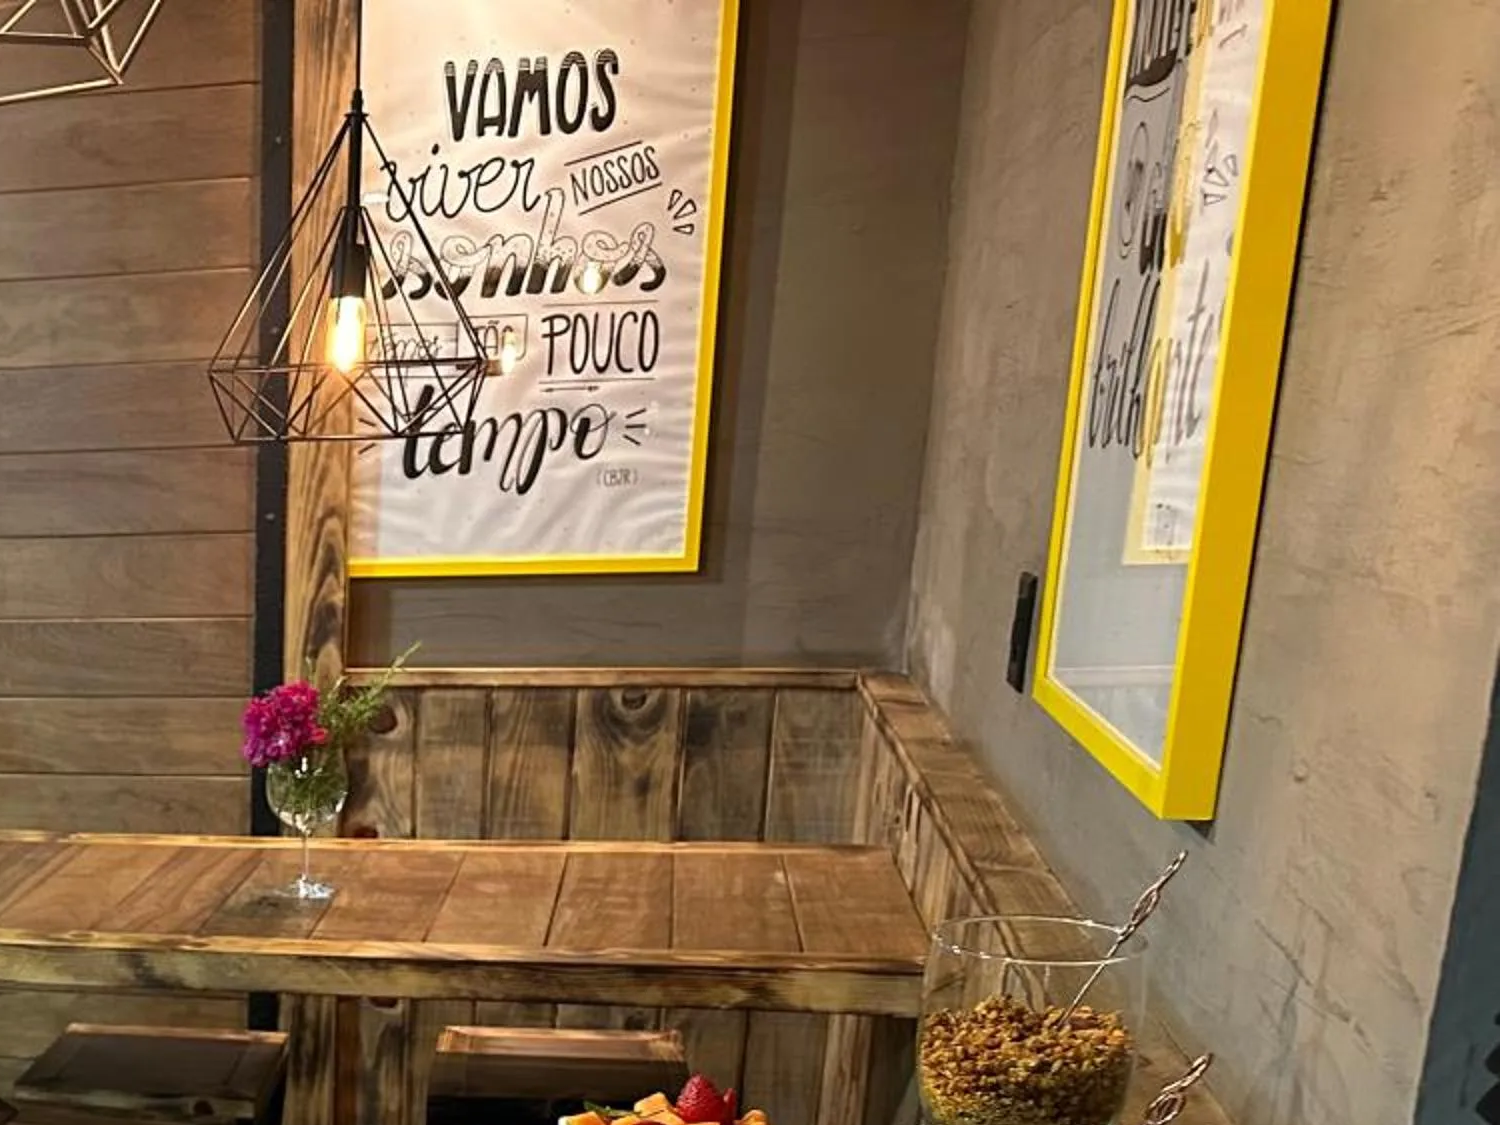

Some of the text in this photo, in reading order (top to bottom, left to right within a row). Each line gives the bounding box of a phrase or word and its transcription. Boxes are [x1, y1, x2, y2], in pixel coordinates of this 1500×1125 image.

[443, 48, 620, 142] VAMOS
[380, 143, 661, 222] viver NOSSOS
[382, 186, 666, 301] sonhos
[540, 310, 660, 376] POUCO
[402, 384, 617, 496] tempo
